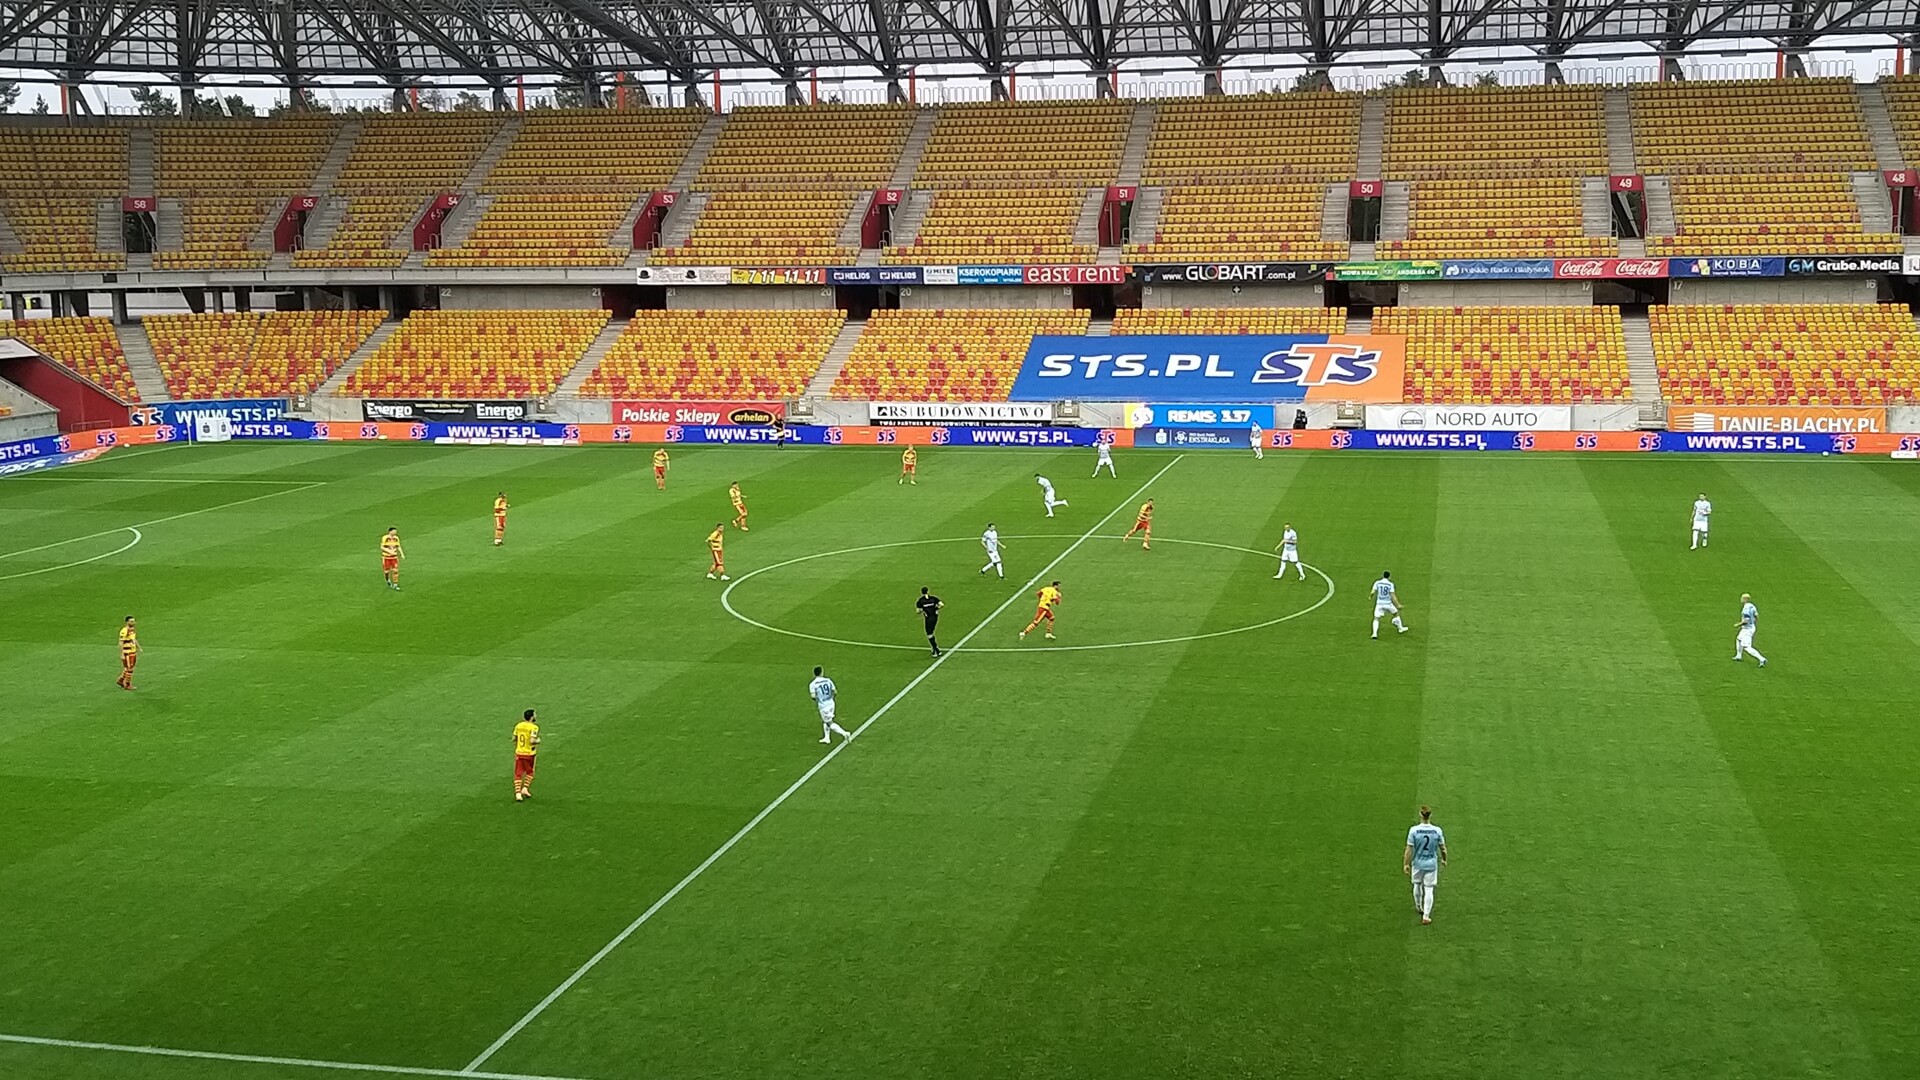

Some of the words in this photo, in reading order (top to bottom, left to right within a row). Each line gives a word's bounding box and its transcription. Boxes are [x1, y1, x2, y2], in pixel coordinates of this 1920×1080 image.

[1619, 178, 1632, 188] 49
[1891, 173, 1905, 183] 48
[1119, 189, 1128, 198] 51
[1361, 184, 1373, 194] 50
[302, 198, 314, 208] 55
[448, 196, 459, 206] 54
[663, 195, 674, 204] 53
[886, 192, 897, 202] 52
[1461, 267, 1489, 275] Polskie
[1490, 266, 1512, 274] Radio
[1714, 259, 1760, 269] KOBA
[1789, 259, 1814, 272] GM
[1817, 260, 1900, 271] Grube.Media
[748, 270, 756, 282] 7
[761, 270, 776, 282] 11
[784, 270, 799, 282] 11
[804, 270, 820, 282] 11
[844, 272, 870, 280] HELIOS
[891, 271, 917, 280] HELIOS
[959, 268, 1022, 276] KSEROKOPIARKI
[1028, 266, 1069, 282] east
[1077, 266, 1120, 282] rent
[441, 288, 451, 296] 22
[592, 288, 600, 296] 21
[667, 288, 676, 296] 21
[821, 287, 832, 296] 20
[901, 287, 912, 296] 20
[1063, 287, 1072, 295] 19
[1144, 286, 1153, 295] 19
[1313, 285, 1323, 294] 18
[1038, 354, 1235, 378] STS.PL
[1252, 343, 1383, 386] STS
[131, 407, 163, 426] STS
[366, 402, 413, 419] Energo
[476, 403, 523, 420] Energo
[621, 408, 669, 422] Polskie
[675, 408, 720, 425] Sklepy
[734, 412, 769, 422] arhelan
[889, 406, 907, 417] RS
[917, 406, 1044, 417] BUDOWNICTWO
[1168, 410, 1217, 423] REMIS:
[1221, 410, 1252, 423] 3.37
[1435, 412, 1487, 426] NORD
[1491, 412, 1538, 426] AUTO
[1718, 416, 1880, 432] TANIE-BLACHY.PL
[156, 425, 176, 441] STS
[312, 422, 329, 438] STS
[361, 424, 378, 439] STS
[411, 424, 428, 439] STS
[447, 426, 540, 438] WWW.STS.PL
[562, 426, 579, 440] STS
[665, 426, 683, 441] STS
[824, 427, 842, 443] STS
[877, 428, 896, 443] STS
[931, 428, 950, 444] STS
[972, 430, 1073, 443] WWW.STS.PL
[97, 431, 117, 447] STS
[1272, 432, 1293, 446] STS
[1331, 432, 1352, 448] STS
[1376, 433, 1487, 447] WWW.STS.PL
[1512, 432, 1534, 449] STS
[1576, 432, 1598, 449] STS
[1639, 432, 1661, 449] STS
[1687, 435, 1806, 449] WWW.STS.PL
[1832, 434, 1856, 451] STS
[1379, 586, 1389, 596] 18
[819, 683, 830, 695] 19
[519, 732, 526, 748] 9
[1422, 835, 1430, 851] 2
